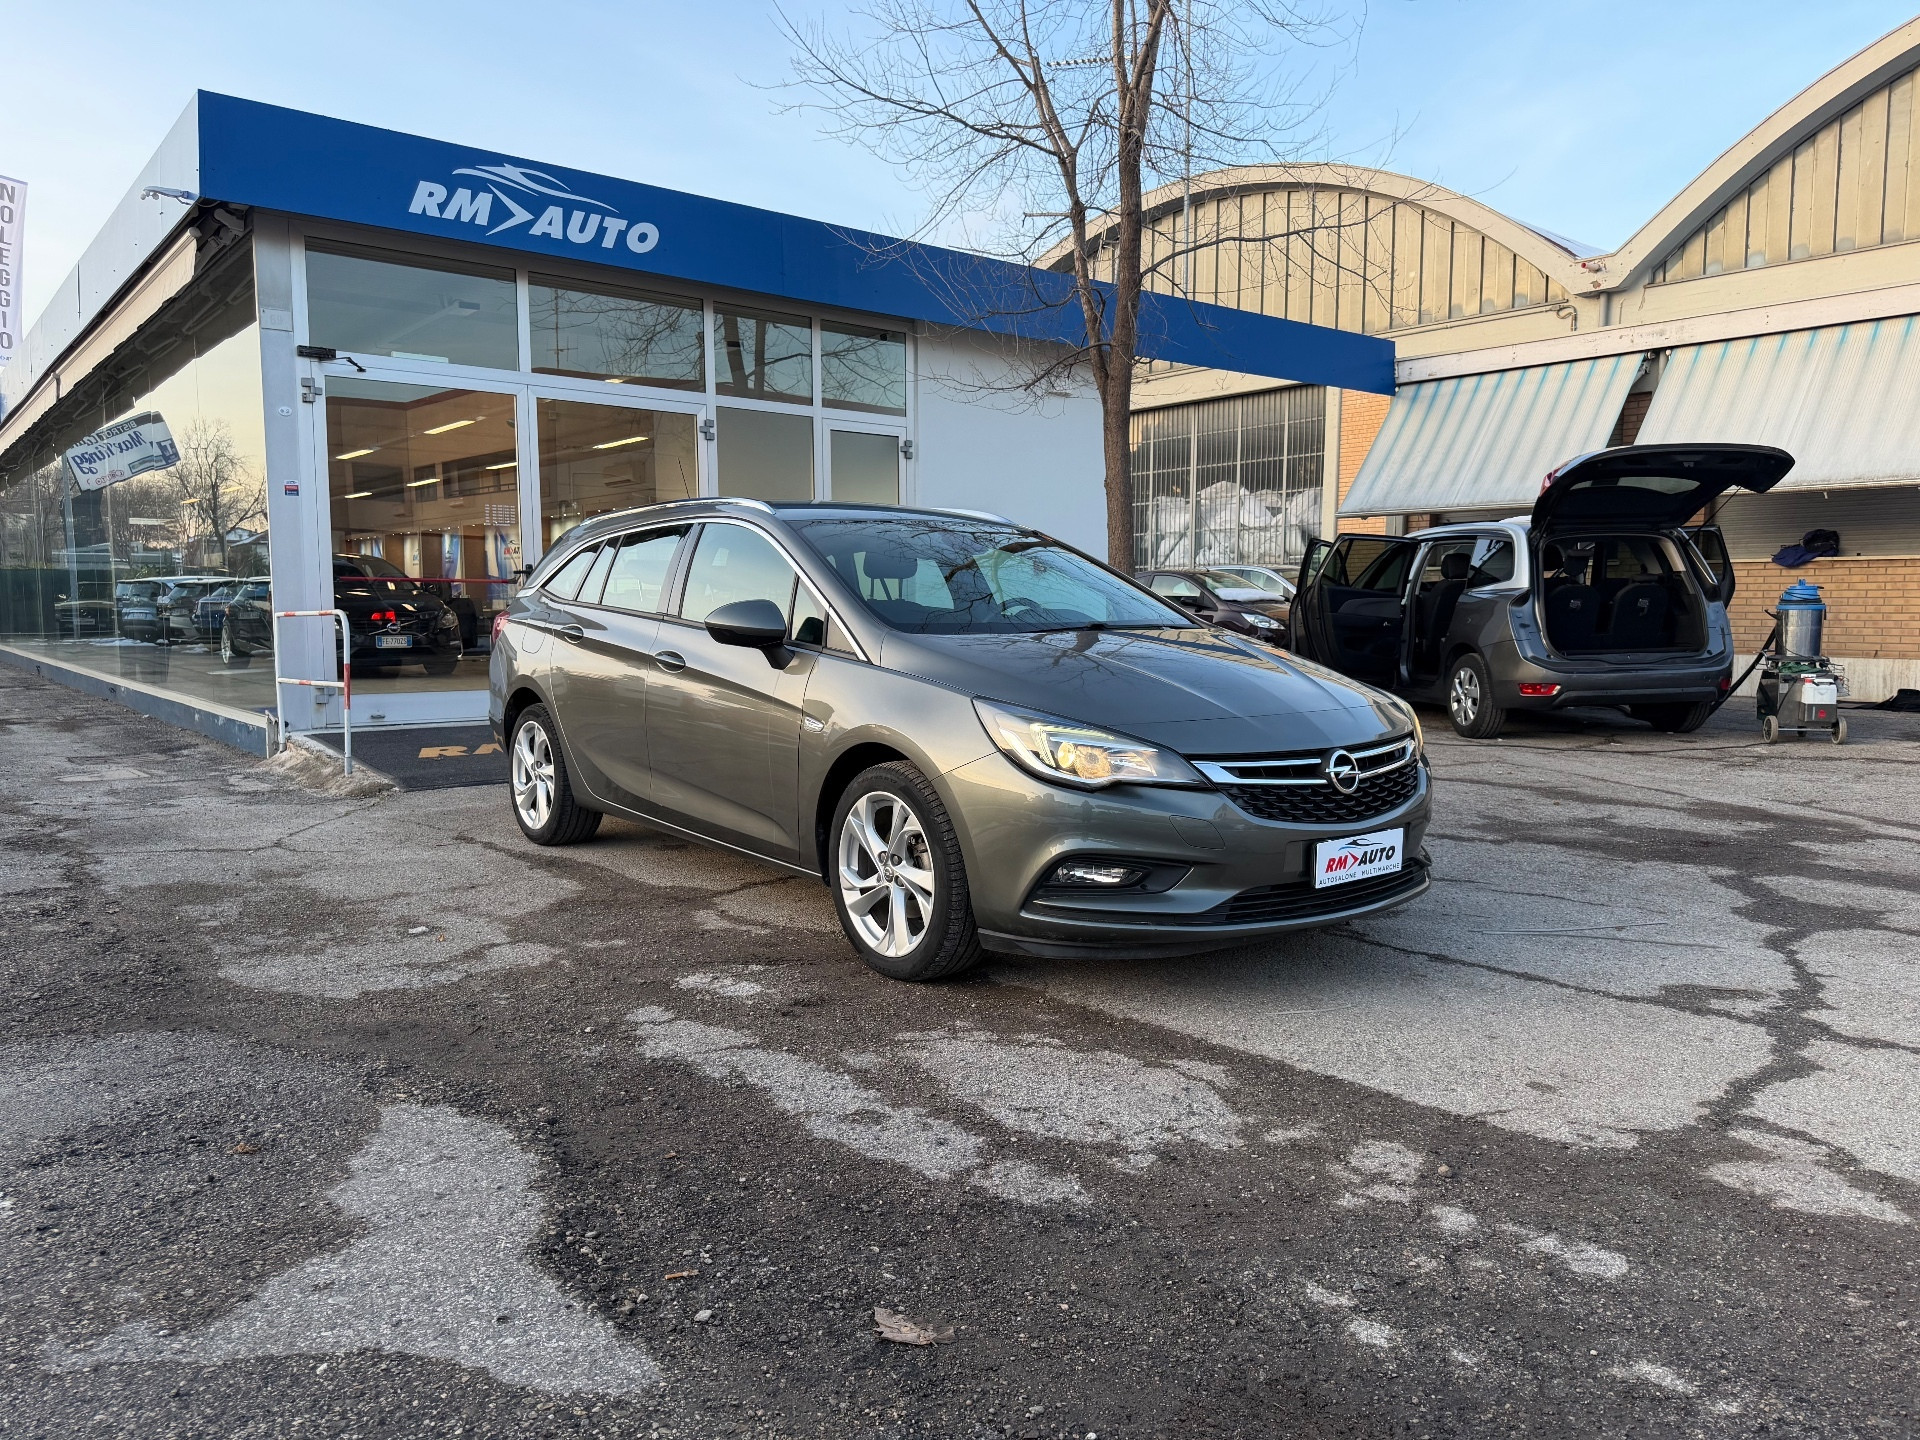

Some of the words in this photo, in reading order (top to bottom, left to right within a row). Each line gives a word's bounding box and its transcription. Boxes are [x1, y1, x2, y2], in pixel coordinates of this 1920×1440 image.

[408, 180, 493, 226] RM
[528, 205, 660, 254] AUTO
[1325, 855, 1349, 873] RM
[1357, 845, 1396, 867] AUTO
[1318, 872, 1357, 886] AUTOSALONE
[1361, 862, 1400, 876] MULTIMARCHE
